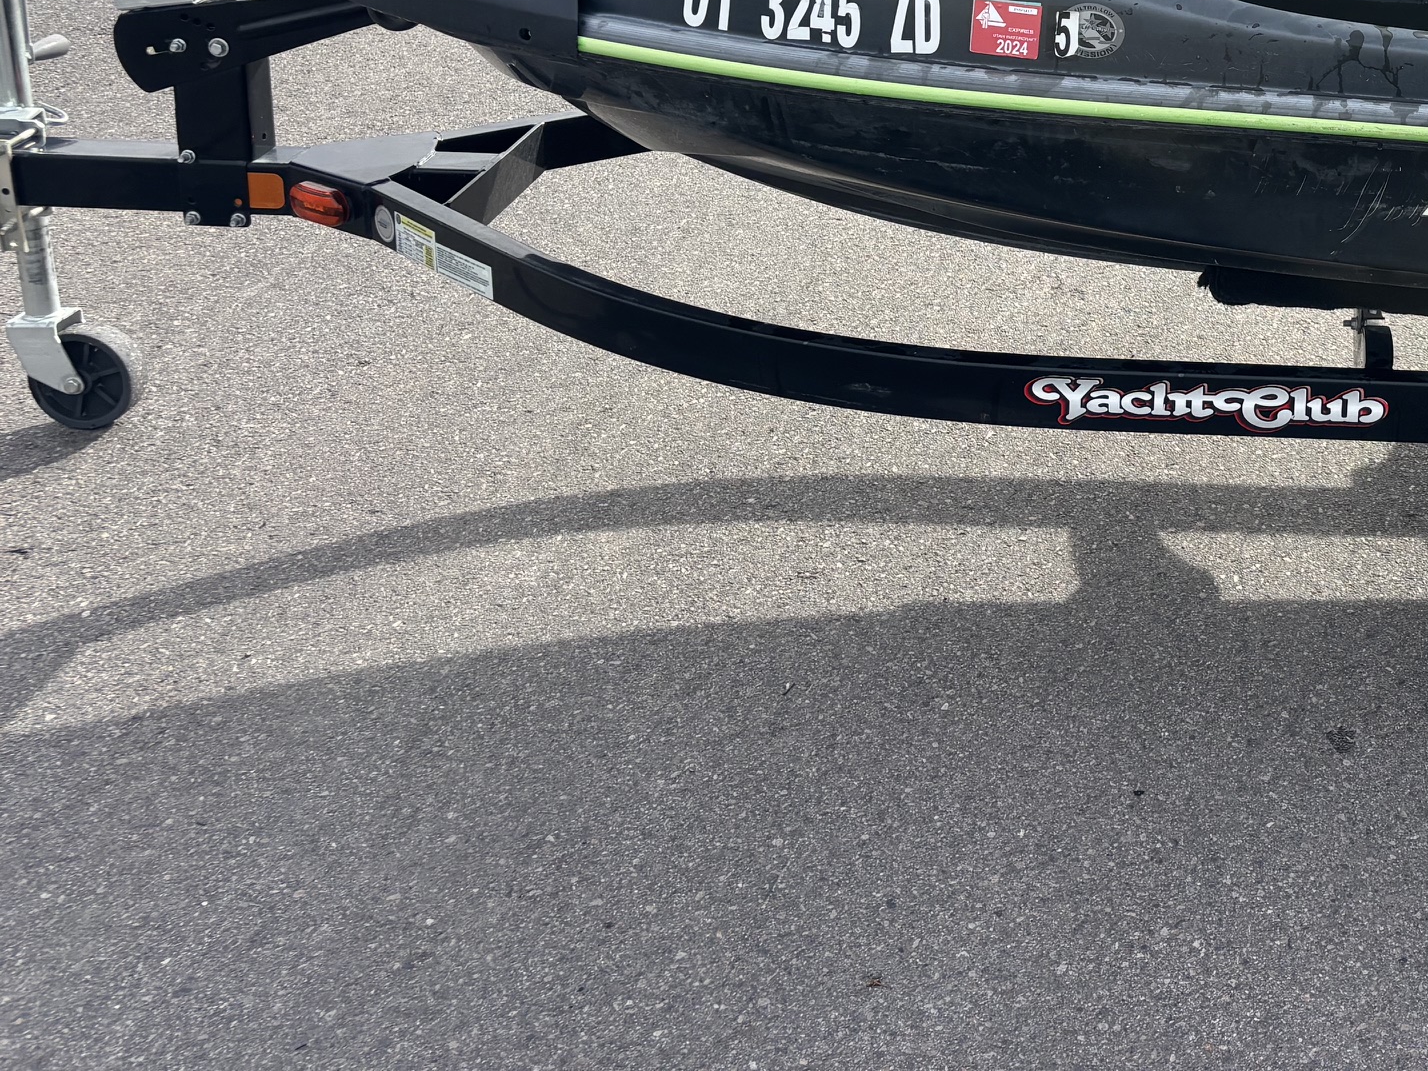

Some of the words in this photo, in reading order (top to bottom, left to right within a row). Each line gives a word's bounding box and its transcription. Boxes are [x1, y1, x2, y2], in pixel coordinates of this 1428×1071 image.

[996, 39, 1028, 56] 2024
[1055, 11, 1071, 58] 5
[1024, 376, 1214, 425] Yacht
[1211, 383, 1390, 433] Club
